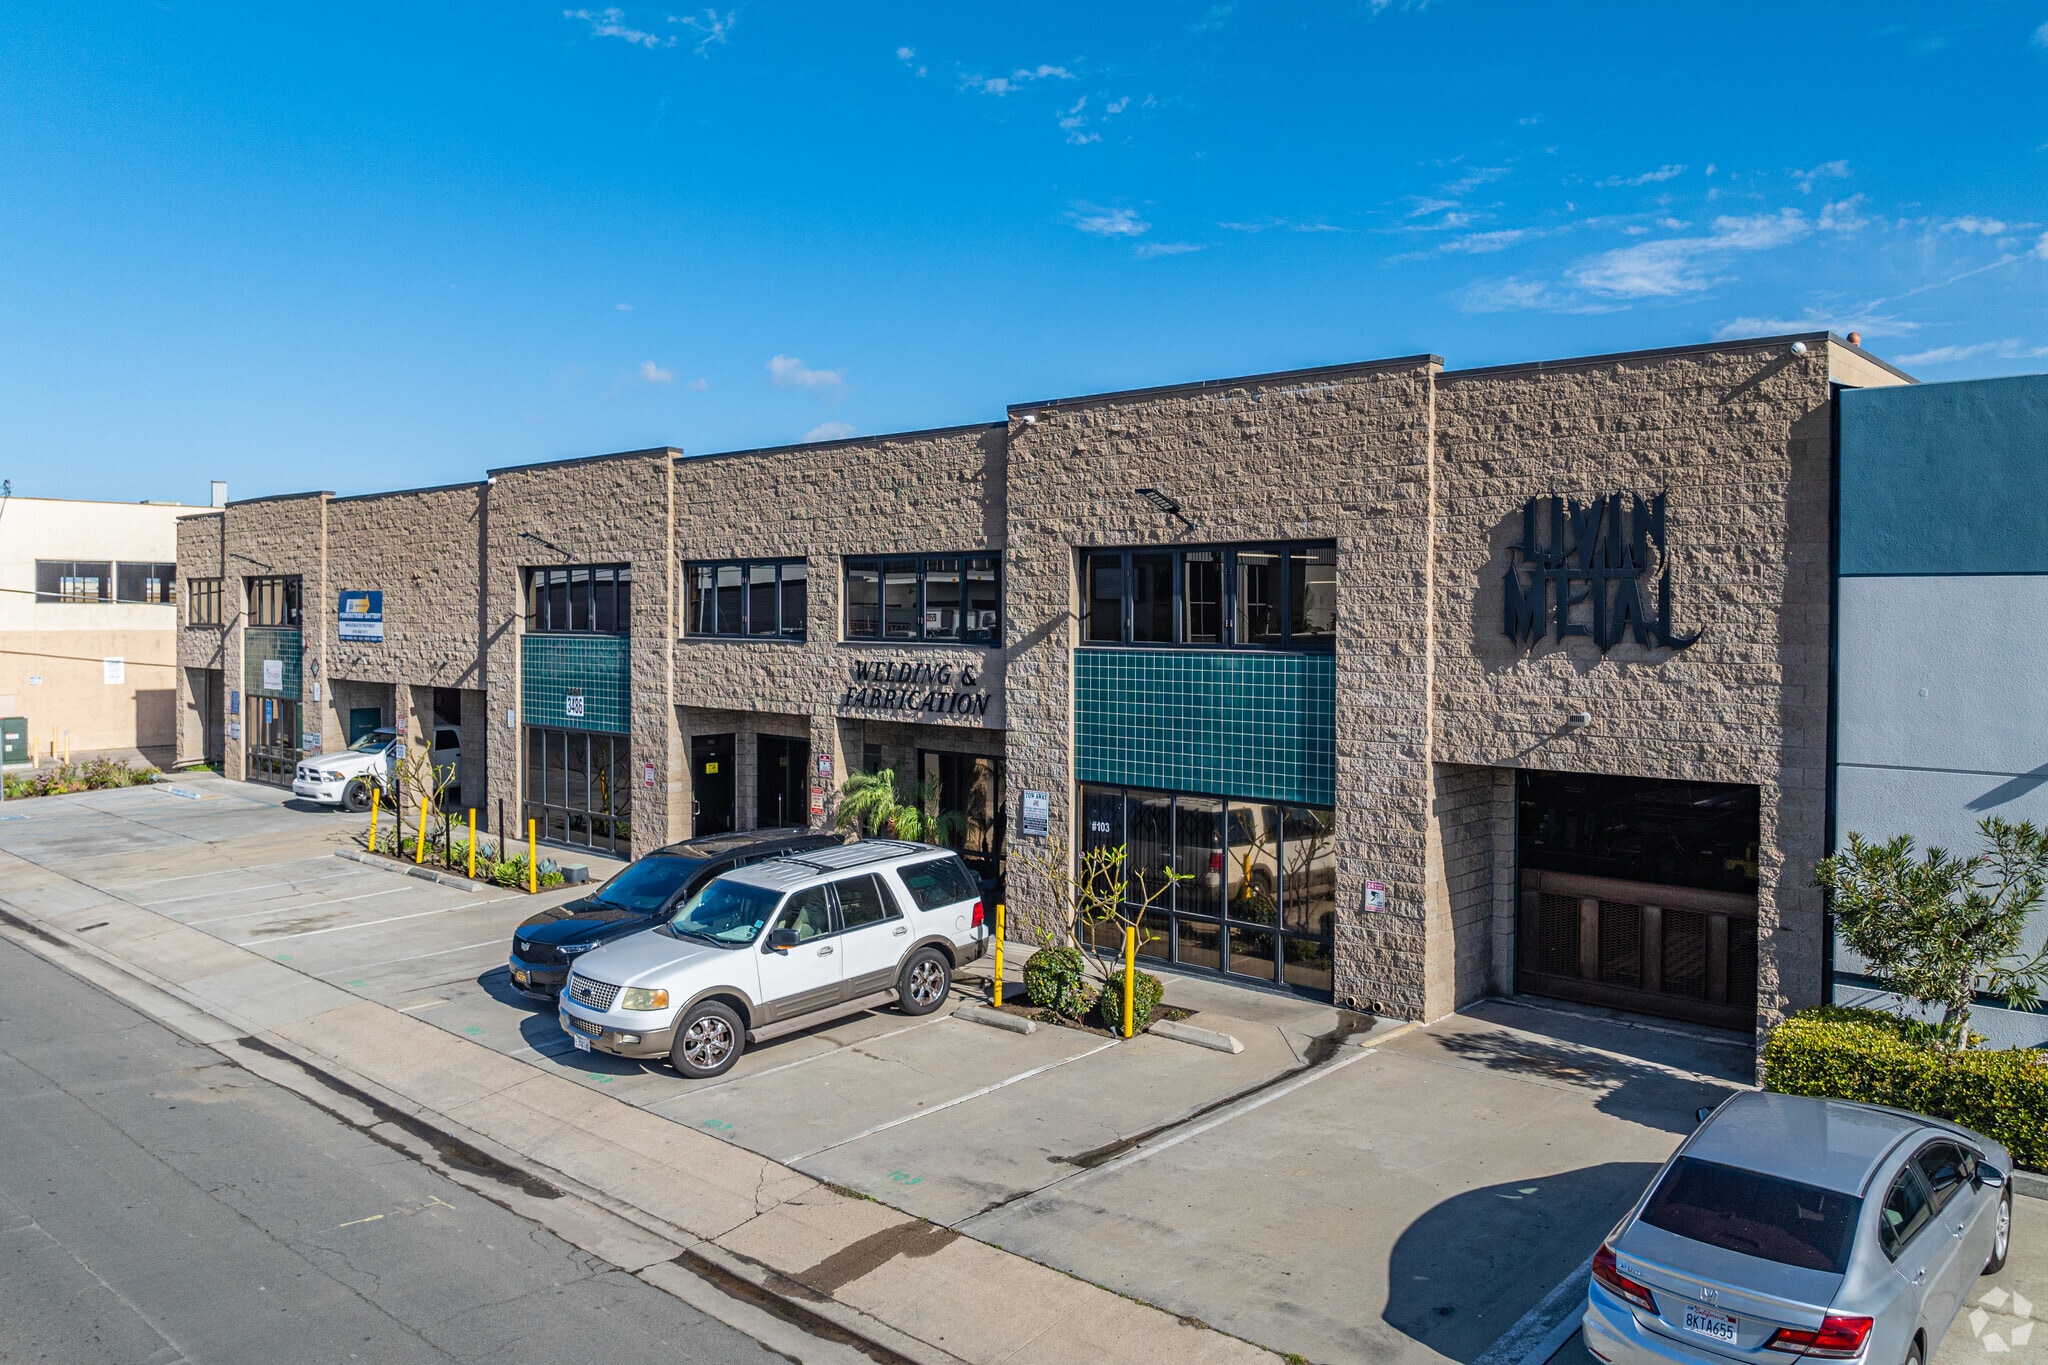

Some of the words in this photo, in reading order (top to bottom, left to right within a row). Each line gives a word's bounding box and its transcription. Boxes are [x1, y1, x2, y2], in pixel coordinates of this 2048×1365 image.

[1502, 541, 1706, 655] METAL
[855, 660, 952, 685] WELDING
[961, 664, 976, 686] &
[568, 697, 583, 714] 3486
[844, 687, 991, 715] FABRICATION
[1091, 820, 1110, 833] #103
[1686, 1312, 1734, 1340] 8KTA655
